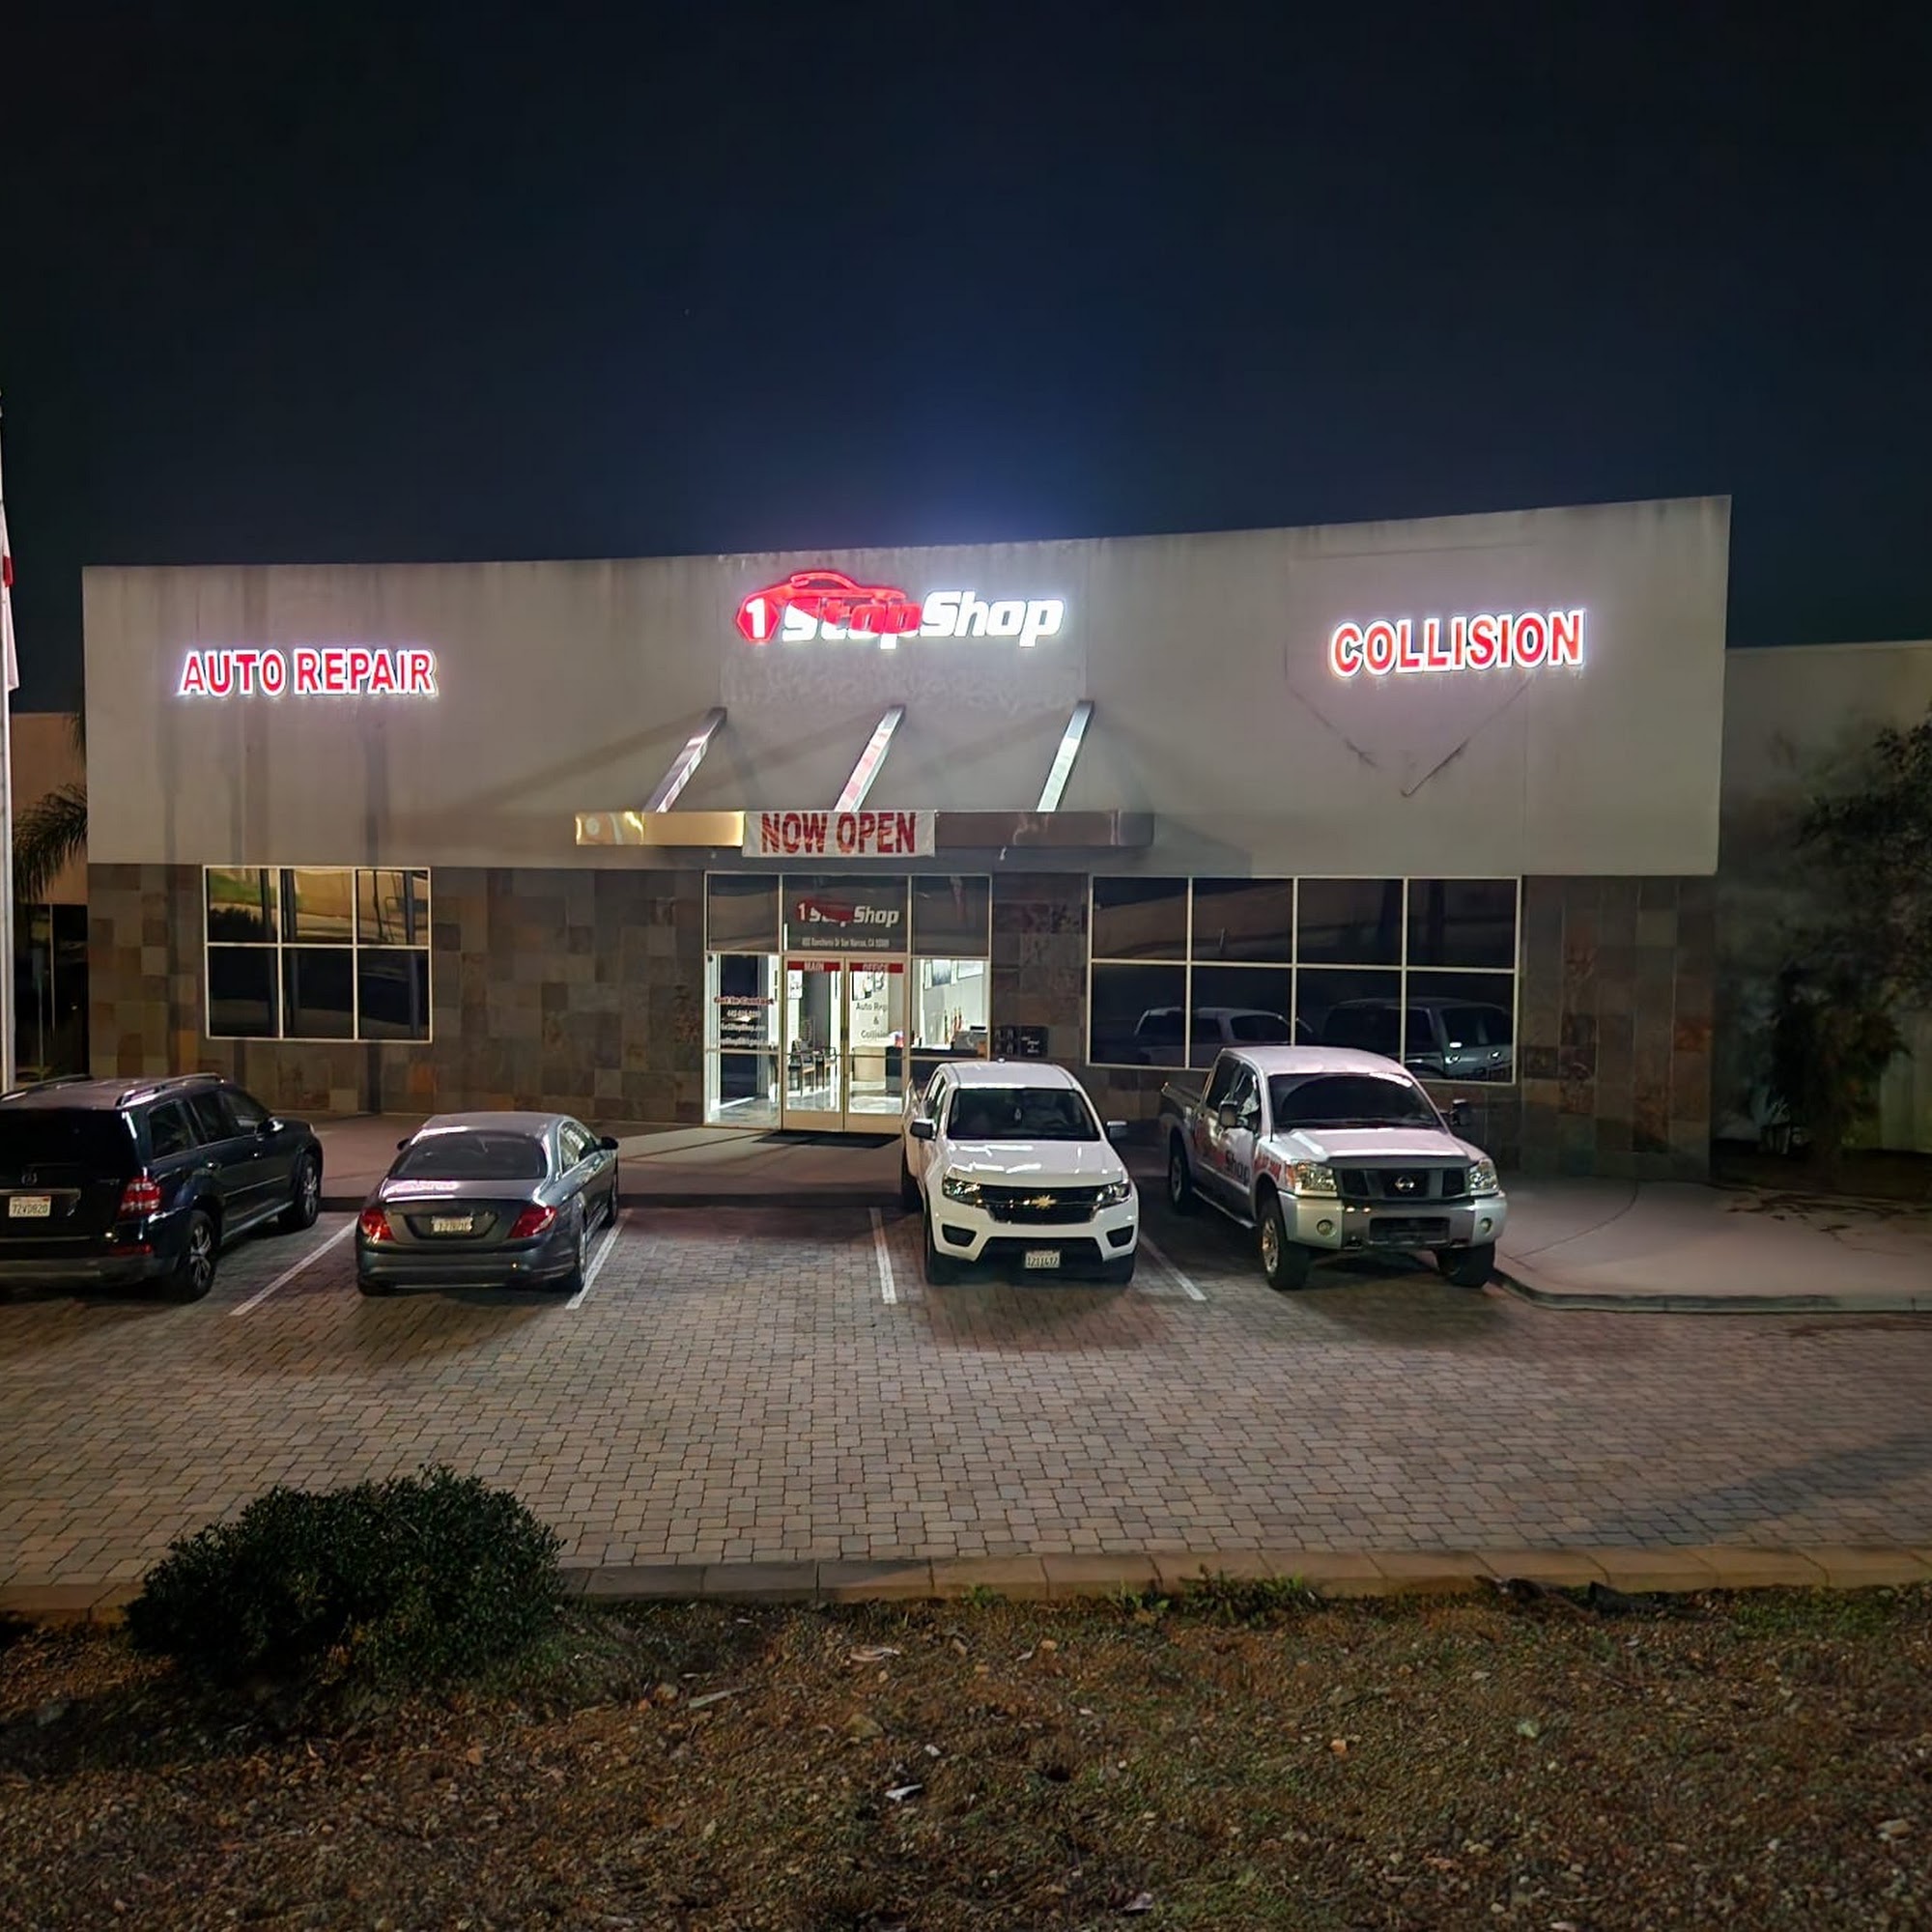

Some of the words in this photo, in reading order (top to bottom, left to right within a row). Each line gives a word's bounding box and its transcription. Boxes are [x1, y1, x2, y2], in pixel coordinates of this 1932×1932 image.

[745, 597, 766, 639] 1
[781, 596, 923, 650] Stop
[922, 590, 1065, 648] Shop
[1330, 609, 1585, 677] COLLISION
[178, 648, 287, 696] AUTO
[293, 647, 438, 696] REPAIR
[761, 812, 828, 853] NOW
[837, 811, 917, 854] OPEN
[853, 905, 900, 928] Shop
[856, 1002, 872, 1010] Auto
